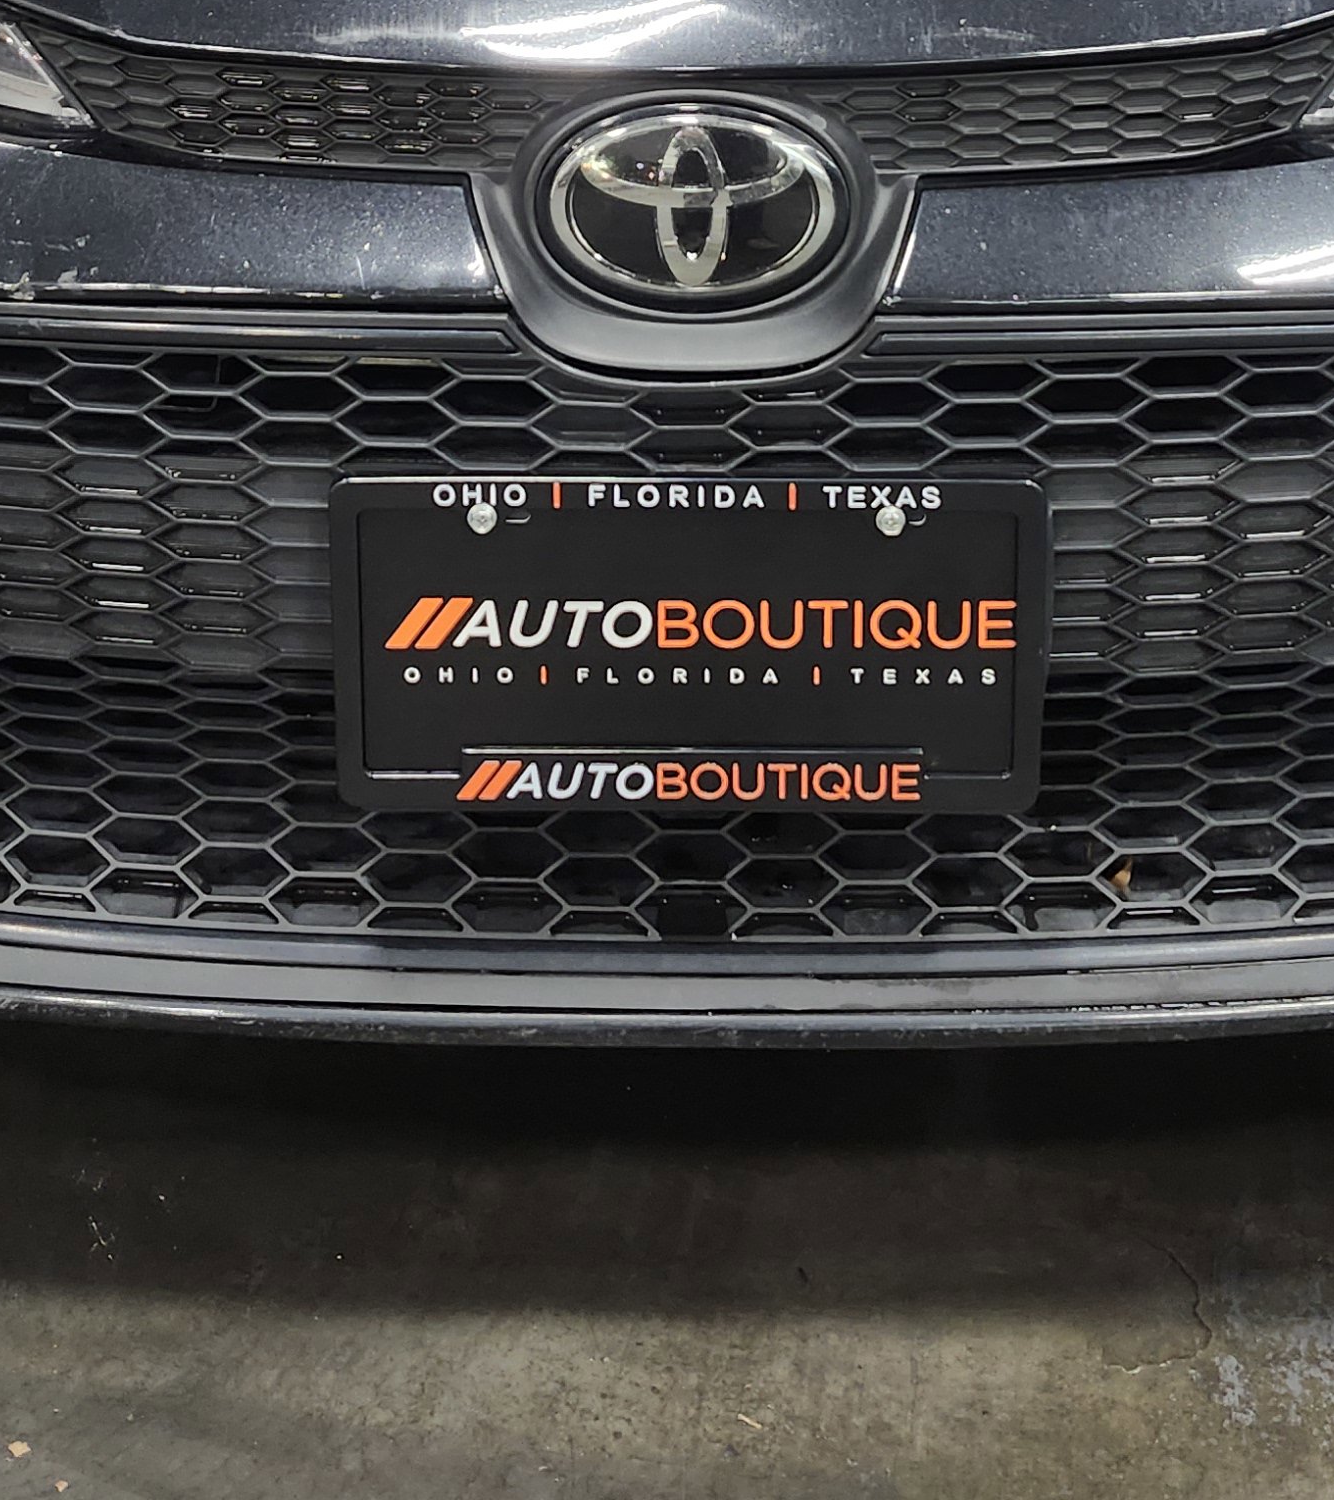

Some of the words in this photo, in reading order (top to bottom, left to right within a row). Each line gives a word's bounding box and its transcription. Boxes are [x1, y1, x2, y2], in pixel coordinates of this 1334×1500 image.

[432, 483, 527, 509] OHIO
[587, 483, 765, 509] FLORIDA
[822, 484, 942, 510] TEXAS
[452, 598, 1018, 650] AUTOBOUTIQUE
[403, 666, 514, 685] OHIO
[576, 666, 779, 685] FLORIDA
[850, 667, 996, 685] TEXAS
[505, 761, 922, 801] AUTOBOUTIQUE
